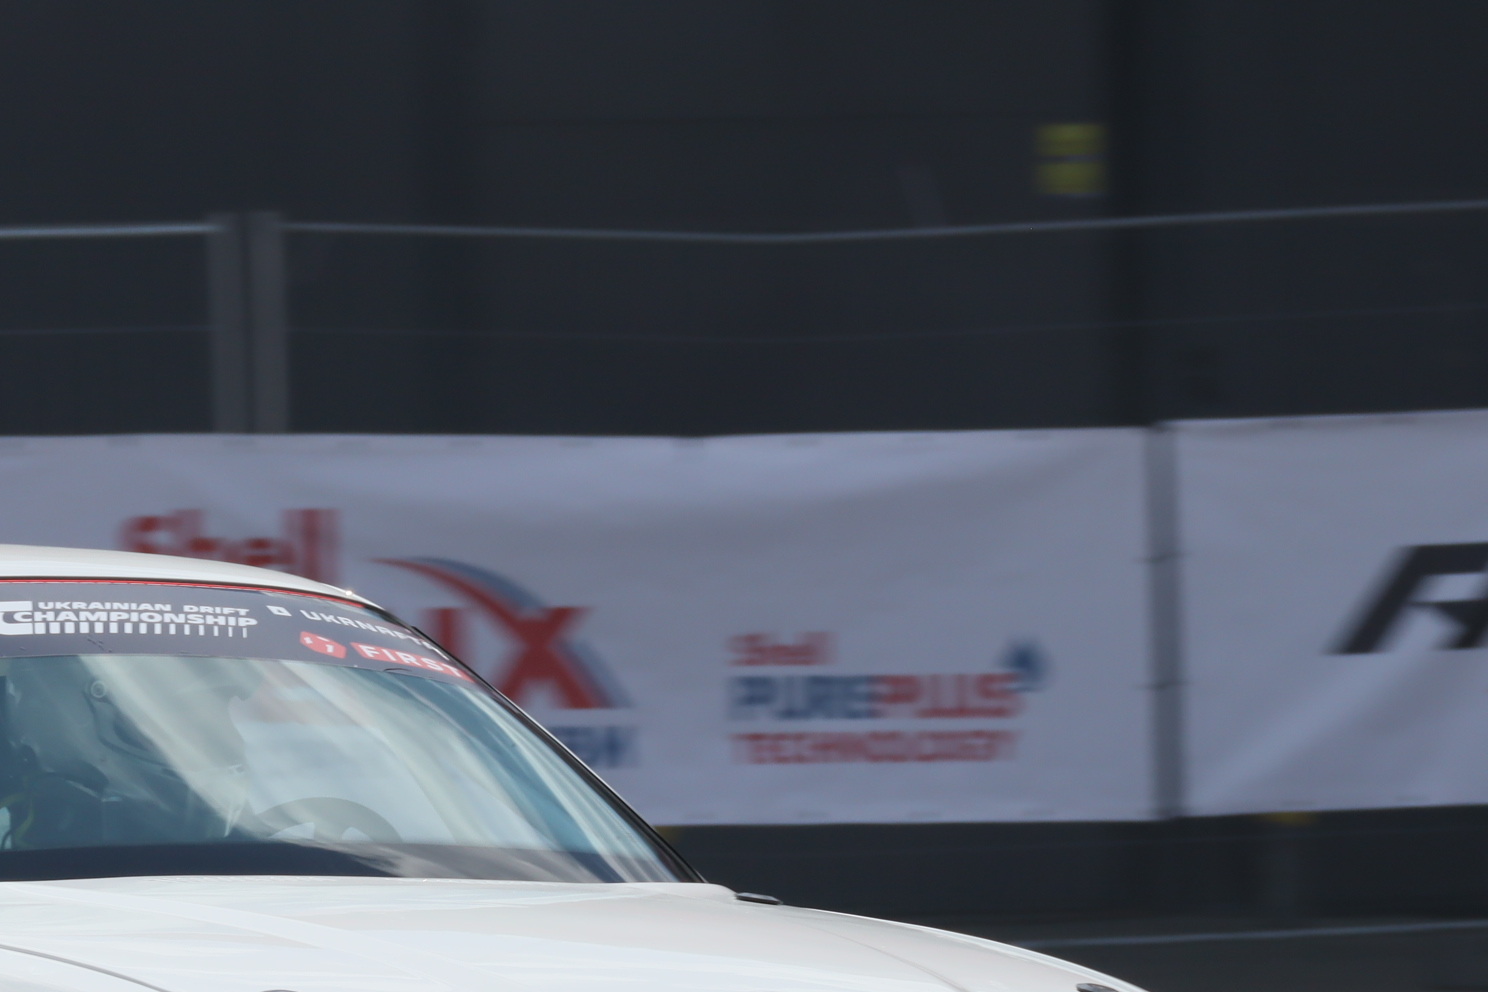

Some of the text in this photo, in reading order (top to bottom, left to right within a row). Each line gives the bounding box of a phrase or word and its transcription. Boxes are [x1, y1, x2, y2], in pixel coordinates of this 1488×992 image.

[38, 601, 250, 616] UKRAINIAN DRIFT
[13, 610, 258, 627] CHAMPIONSHIP
[357, 644, 463, 678] FIRST
